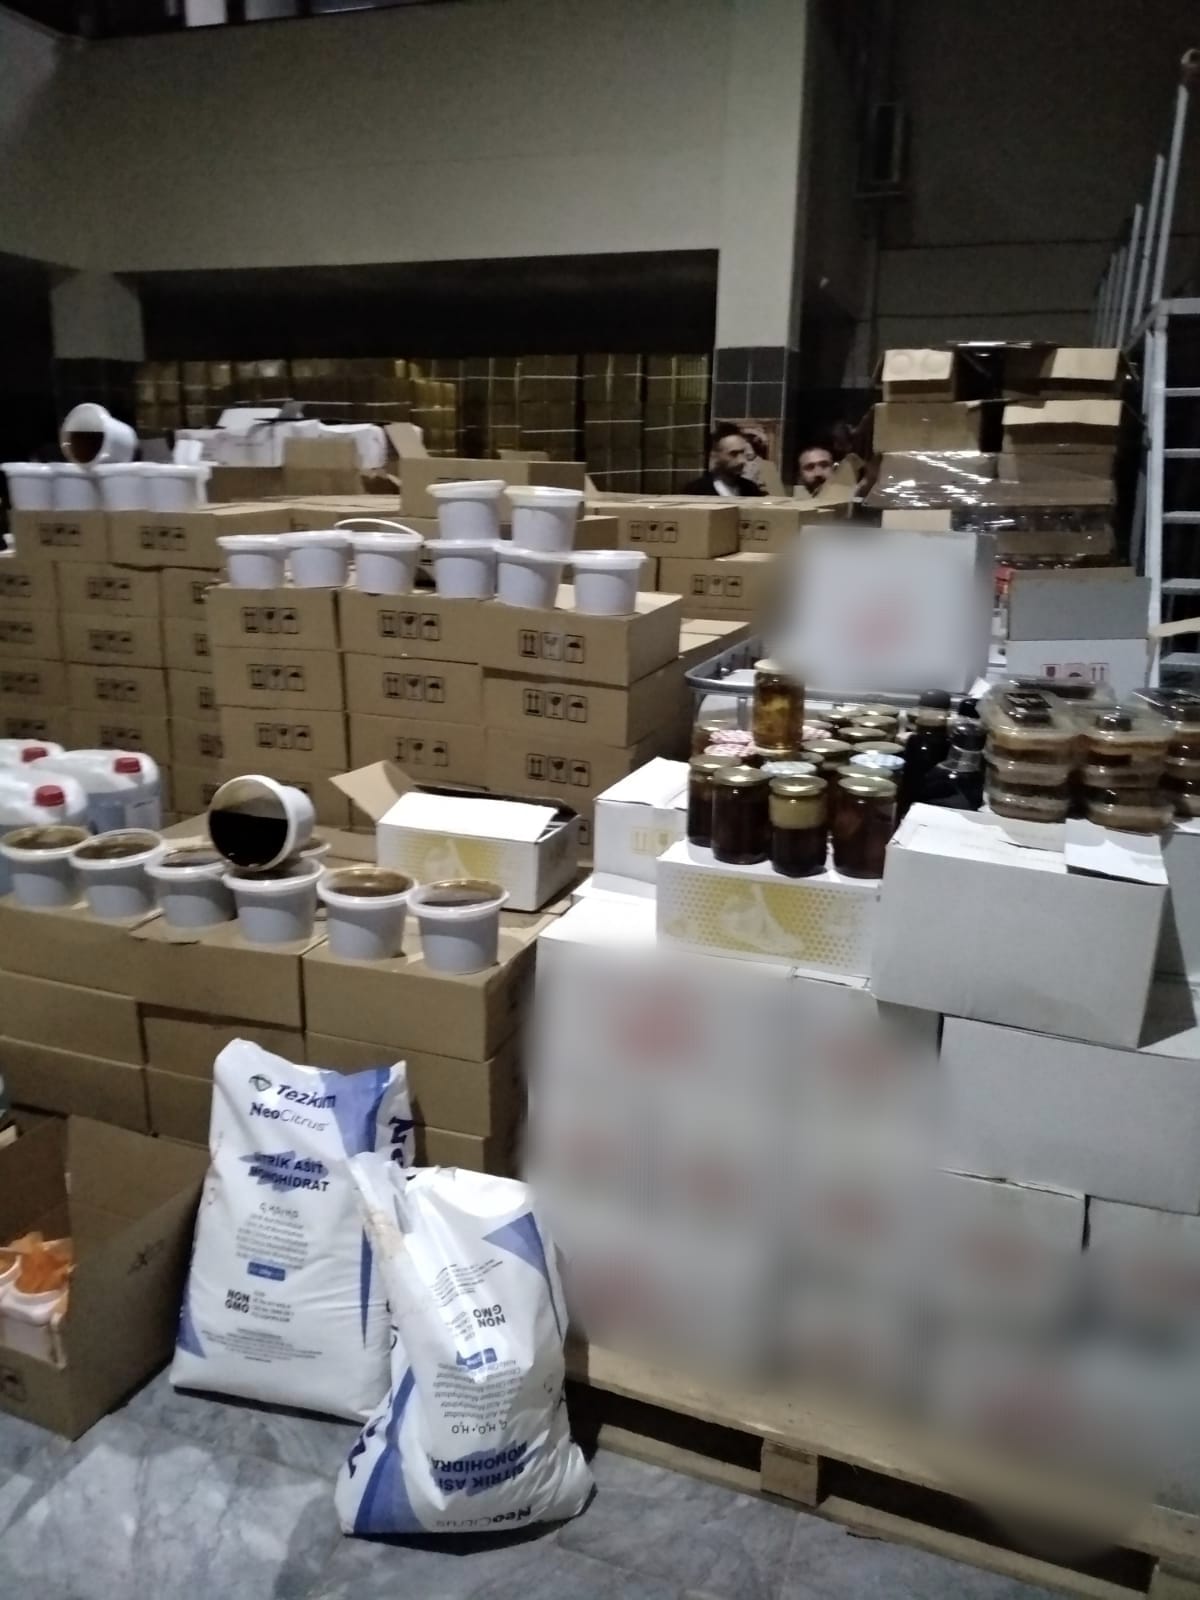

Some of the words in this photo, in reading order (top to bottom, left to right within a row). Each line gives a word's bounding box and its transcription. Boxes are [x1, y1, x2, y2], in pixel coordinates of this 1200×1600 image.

[250, 1102, 329, 1131] NeoCitrus
[227, 1289, 250, 1302] NON
[224, 1299, 250, 1313] GMO
[473, 1304, 502, 1318] GMO
[478, 1314, 506, 1328] NON
